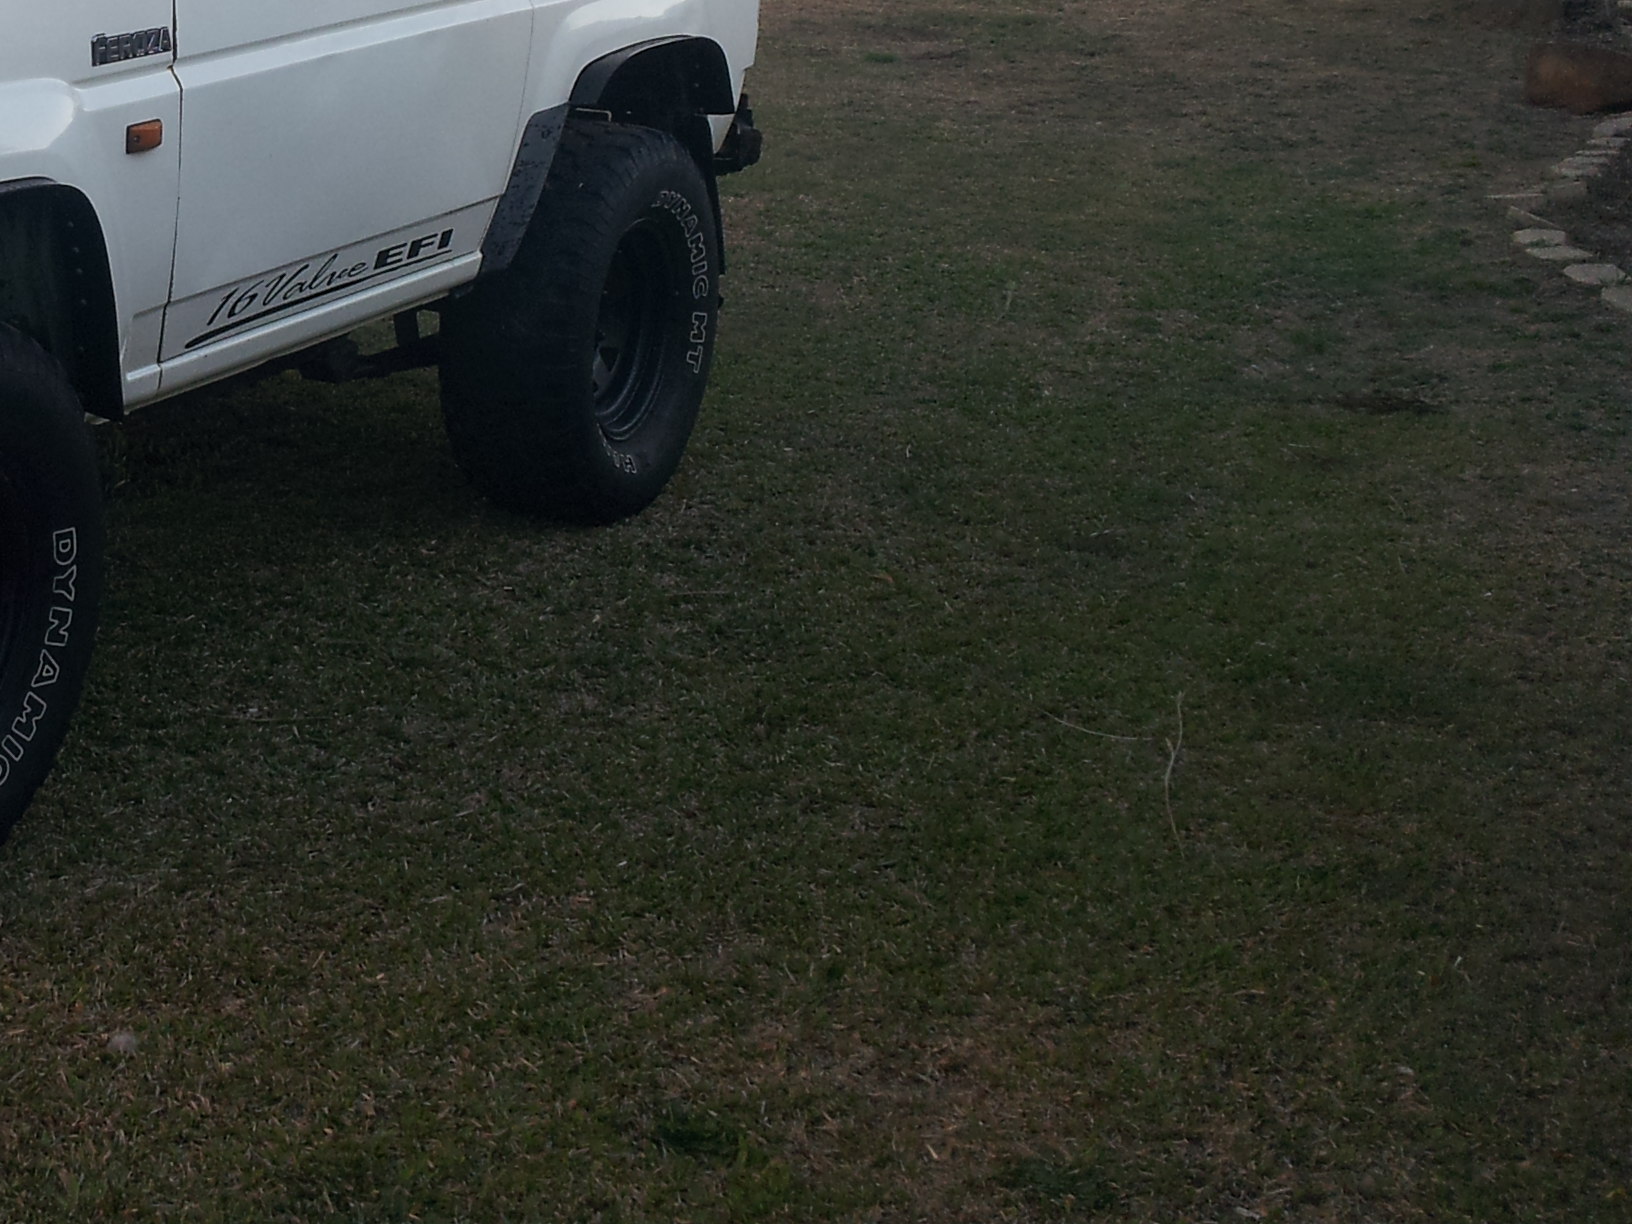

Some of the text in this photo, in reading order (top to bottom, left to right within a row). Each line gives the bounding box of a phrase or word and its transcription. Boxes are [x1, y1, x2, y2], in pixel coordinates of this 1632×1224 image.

[91, 27, 172, 67] FEROZA
[207, 228, 454, 326] 16 Valve EFI
[651, 190, 709, 374] DYNAMIC MT
